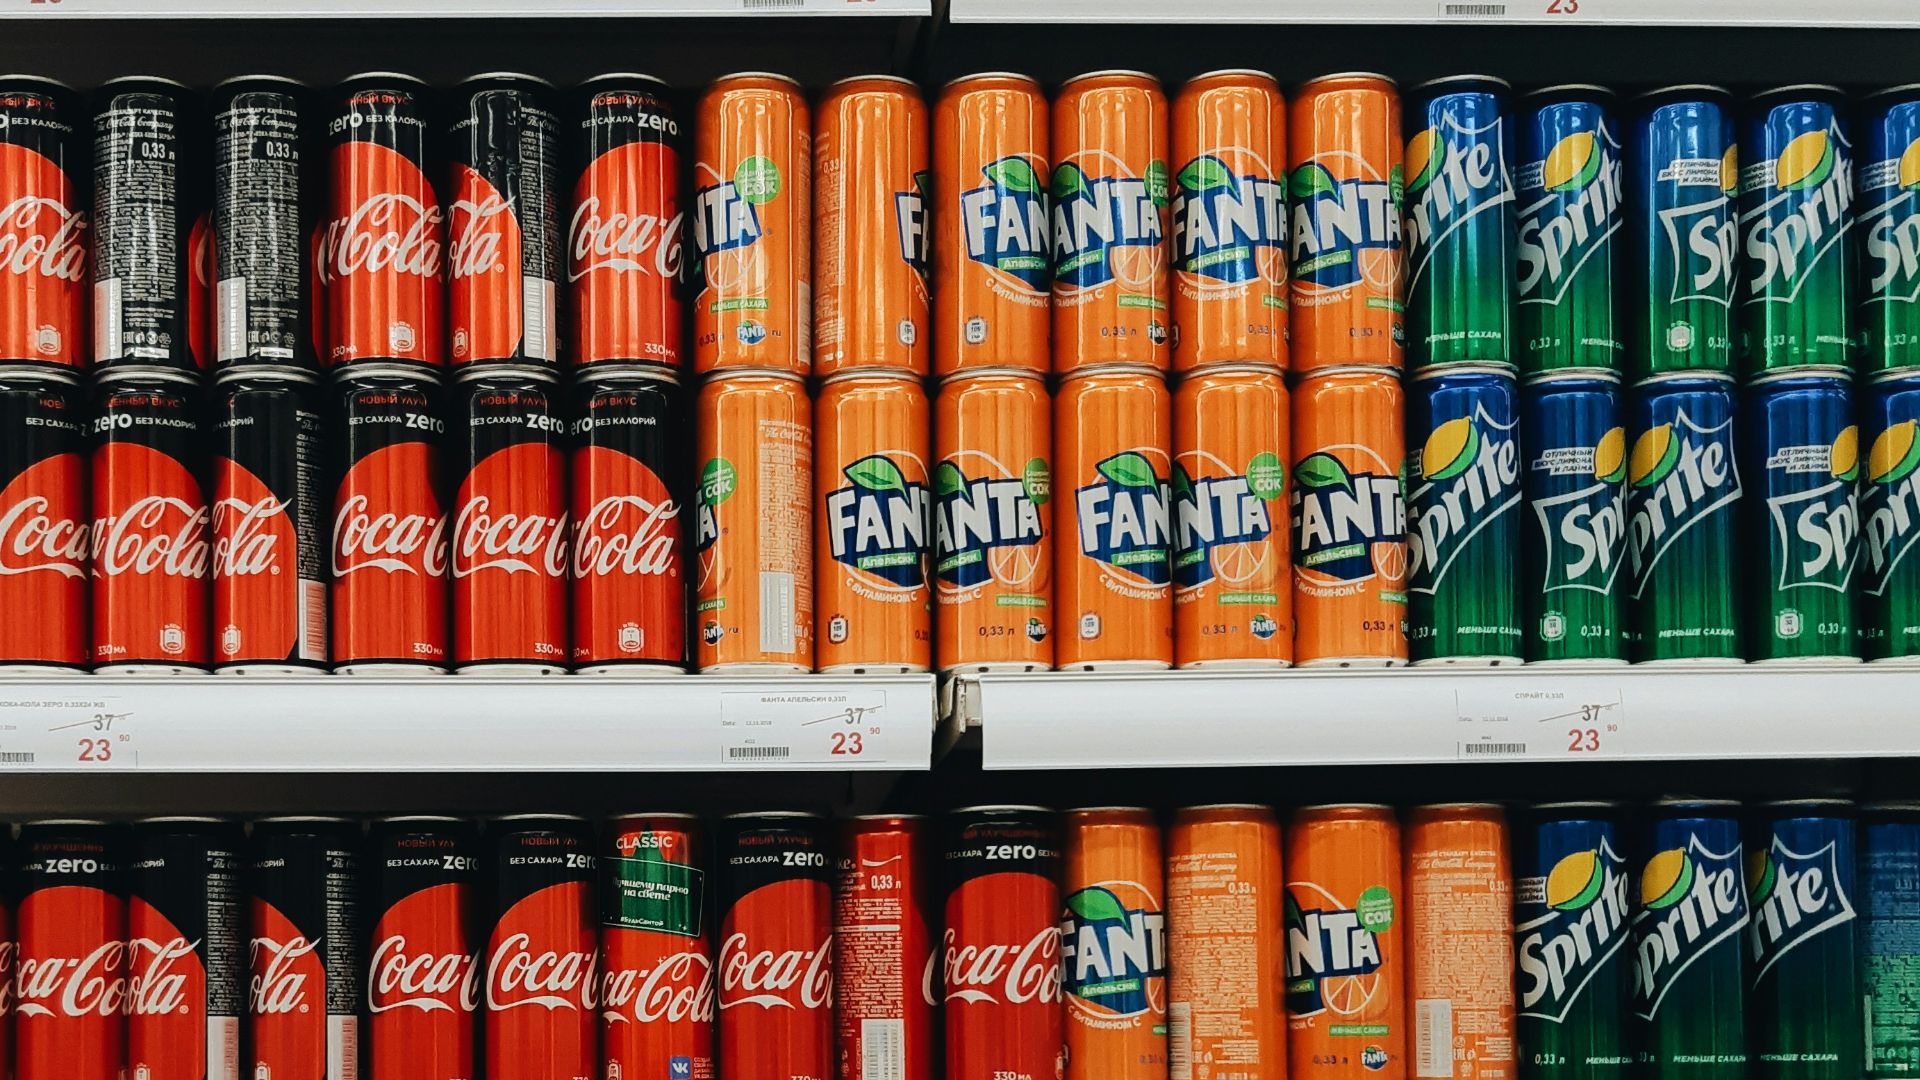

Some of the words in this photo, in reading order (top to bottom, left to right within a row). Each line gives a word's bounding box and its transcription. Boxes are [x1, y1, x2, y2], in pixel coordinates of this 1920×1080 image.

[11, 117, 29, 125] БЕЗ
[328, 112, 363, 136] zero
[366, 115, 383, 123] БЕЗ
[598, 116, 634, 126] САХАРА
[638, 113, 678, 135] zero
[141, 141, 165, 159] 0,33
[266, 141, 289, 158] 0,33
[1467, 330, 1501, 339] САХАРА
[359, 393, 398, 405] НОВЫЙ
[481, 393, 519, 405] НОВЫЙ
[609, 396, 637, 407] ВКУС
[26, 417, 43, 426] БЕЗ
[93, 413, 132, 433] zero
[135, 416, 153, 425] БЕЗ
[155, 418, 196, 430] КАЛОРИЙ
[365, 415, 402, 424] САХАРА
[405, 413, 445, 434] zero
[487, 416, 523, 425] САХАРА
[526, 413, 564, 434] zero
[595, 418, 611, 427] БЕЗ
[613, 417, 656, 427] КАЛОРИЙ
[705, 481, 732, 499] СОК
[1255, 478, 1281, 492] СОК
[1173, 478, 1270, 550] NTA
[979, 626, 1004, 638] 0,33
[1007, 628, 1015, 636] л
[1363, 621, 1385, 632] 0,33
[1457, 626, 1497, 634] МЕНЬШЕ
[1580, 625, 1602, 638] 0,33
[1659, 628, 1700, 638] МЕНЬШЕ
[1702, 627, 1735, 637] САХАРА
[1818, 622, 1839, 635] 0,33
[760, 695, 785, 703] ФАНТА
[787, 695, 827, 703] АПЕЛЬСИН
[844, 707, 865, 725] 37
[1581, 704, 1601, 721] 37
[94, 713, 115, 731] 37
[1607, 724, 1618, 732] 90
[869, 727, 881, 735] 90
[119, 734, 131, 742] 90
[831, 732, 863, 755] 23
[1567, 729, 1600, 752] 23
[78, 737, 112, 762] 23
[616, 836, 673, 850] CLASSIC
[985, 844, 1037, 860] zero
[45, 858, 98, 873] zero
[387, 858, 402, 867] БЕЗ
[404, 858, 440, 867] САХАРА
[510, 857, 525, 866] БЕЗ
[527, 856, 563, 865] САХАРА
[744, 855, 779, 864] САХАРА
[782, 851, 824, 867] zero
[871, 875, 893, 890] 0,33
[1228, 881, 1250, 895] 0,33
[624, 889, 636, 897] на
[638, 889, 672, 901] свете
[656, 883, 689, 896] парню
[1364, 910, 1392, 925] СОК
[1061, 913, 1165, 982] FANT
[1534, 1054, 1556, 1065] 0,33
[1673, 1054, 1715, 1063] МЕНЬШЕ
[1800, 1053, 1839, 1062] САХАРА
